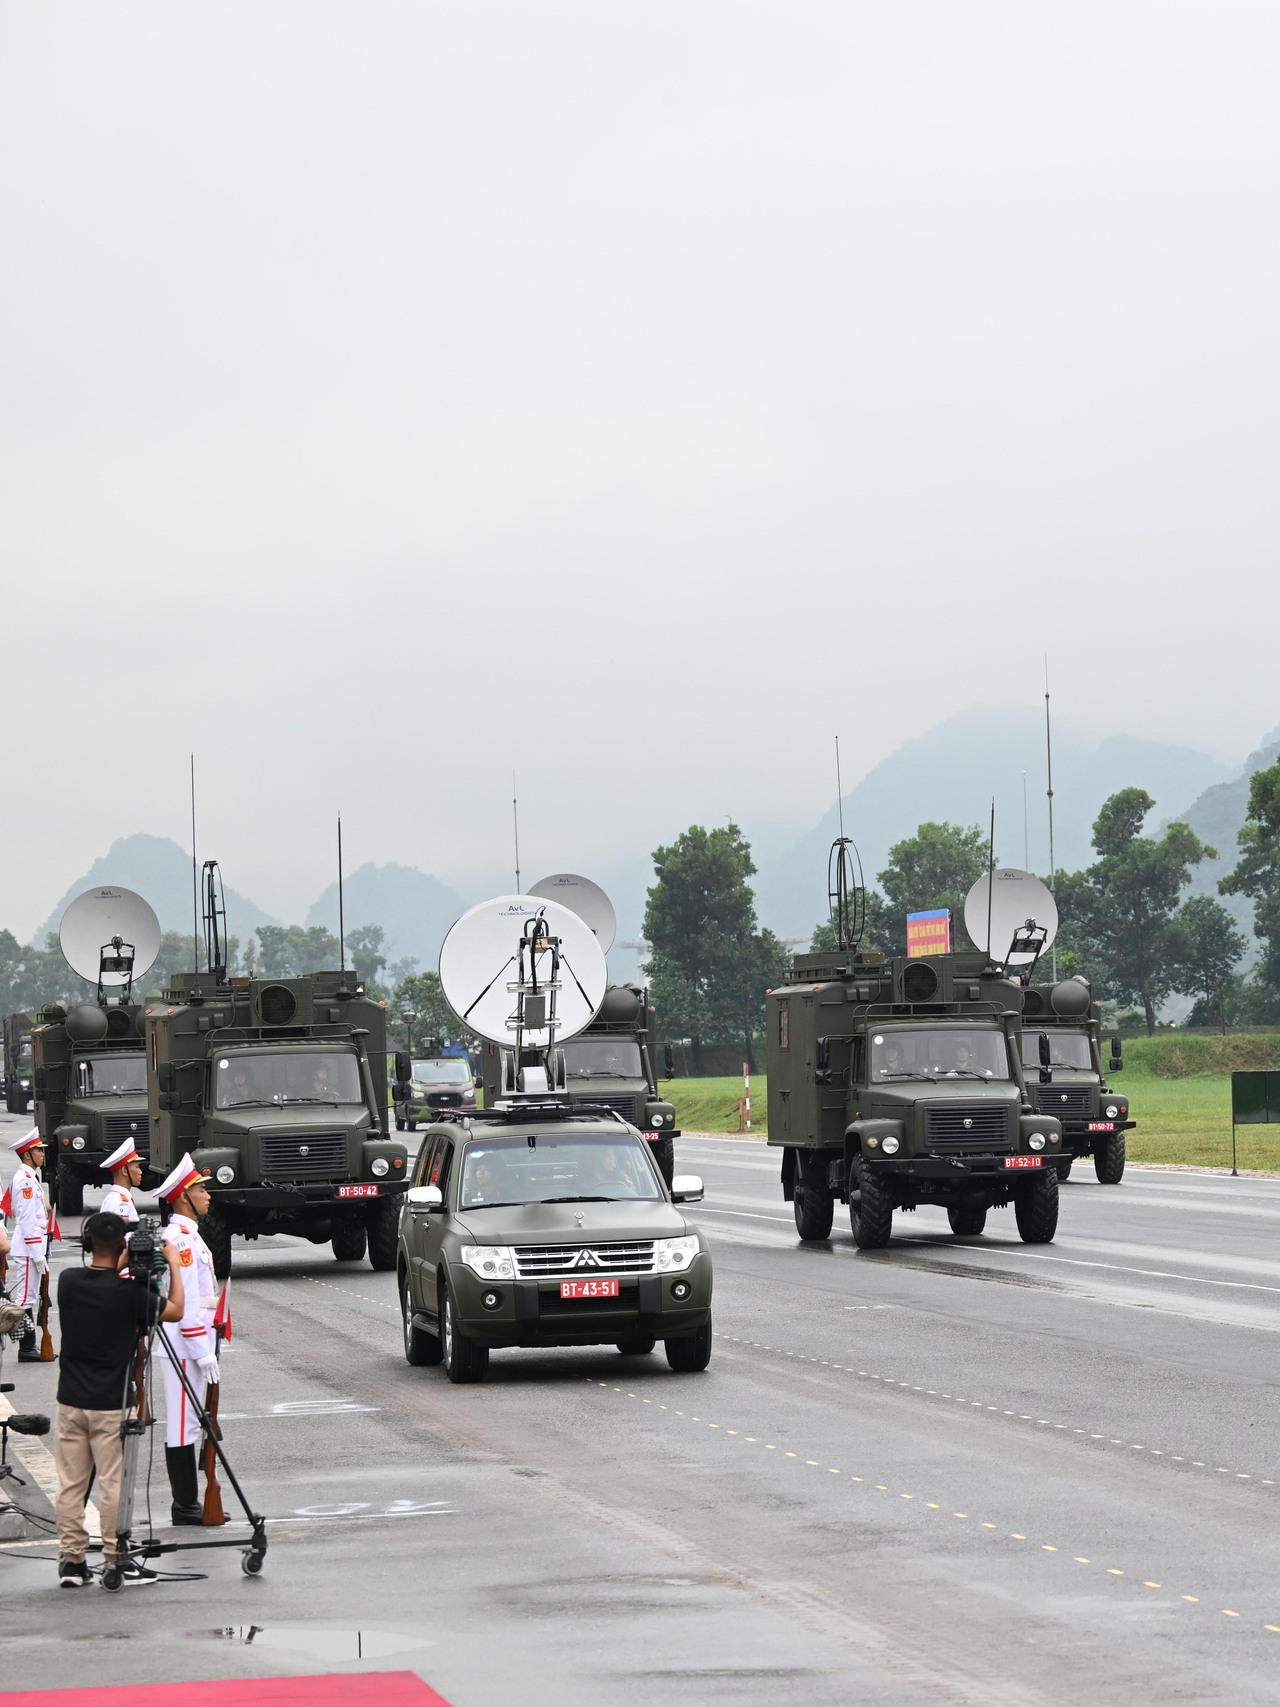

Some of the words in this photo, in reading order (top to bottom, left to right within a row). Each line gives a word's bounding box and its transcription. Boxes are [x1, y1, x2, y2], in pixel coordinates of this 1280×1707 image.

[1005, 1157, 1041, 1167] BT-52-10
[340, 1186, 377, 1196] BT-50-42
[562, 1282, 615, 1297] BT-43-51
